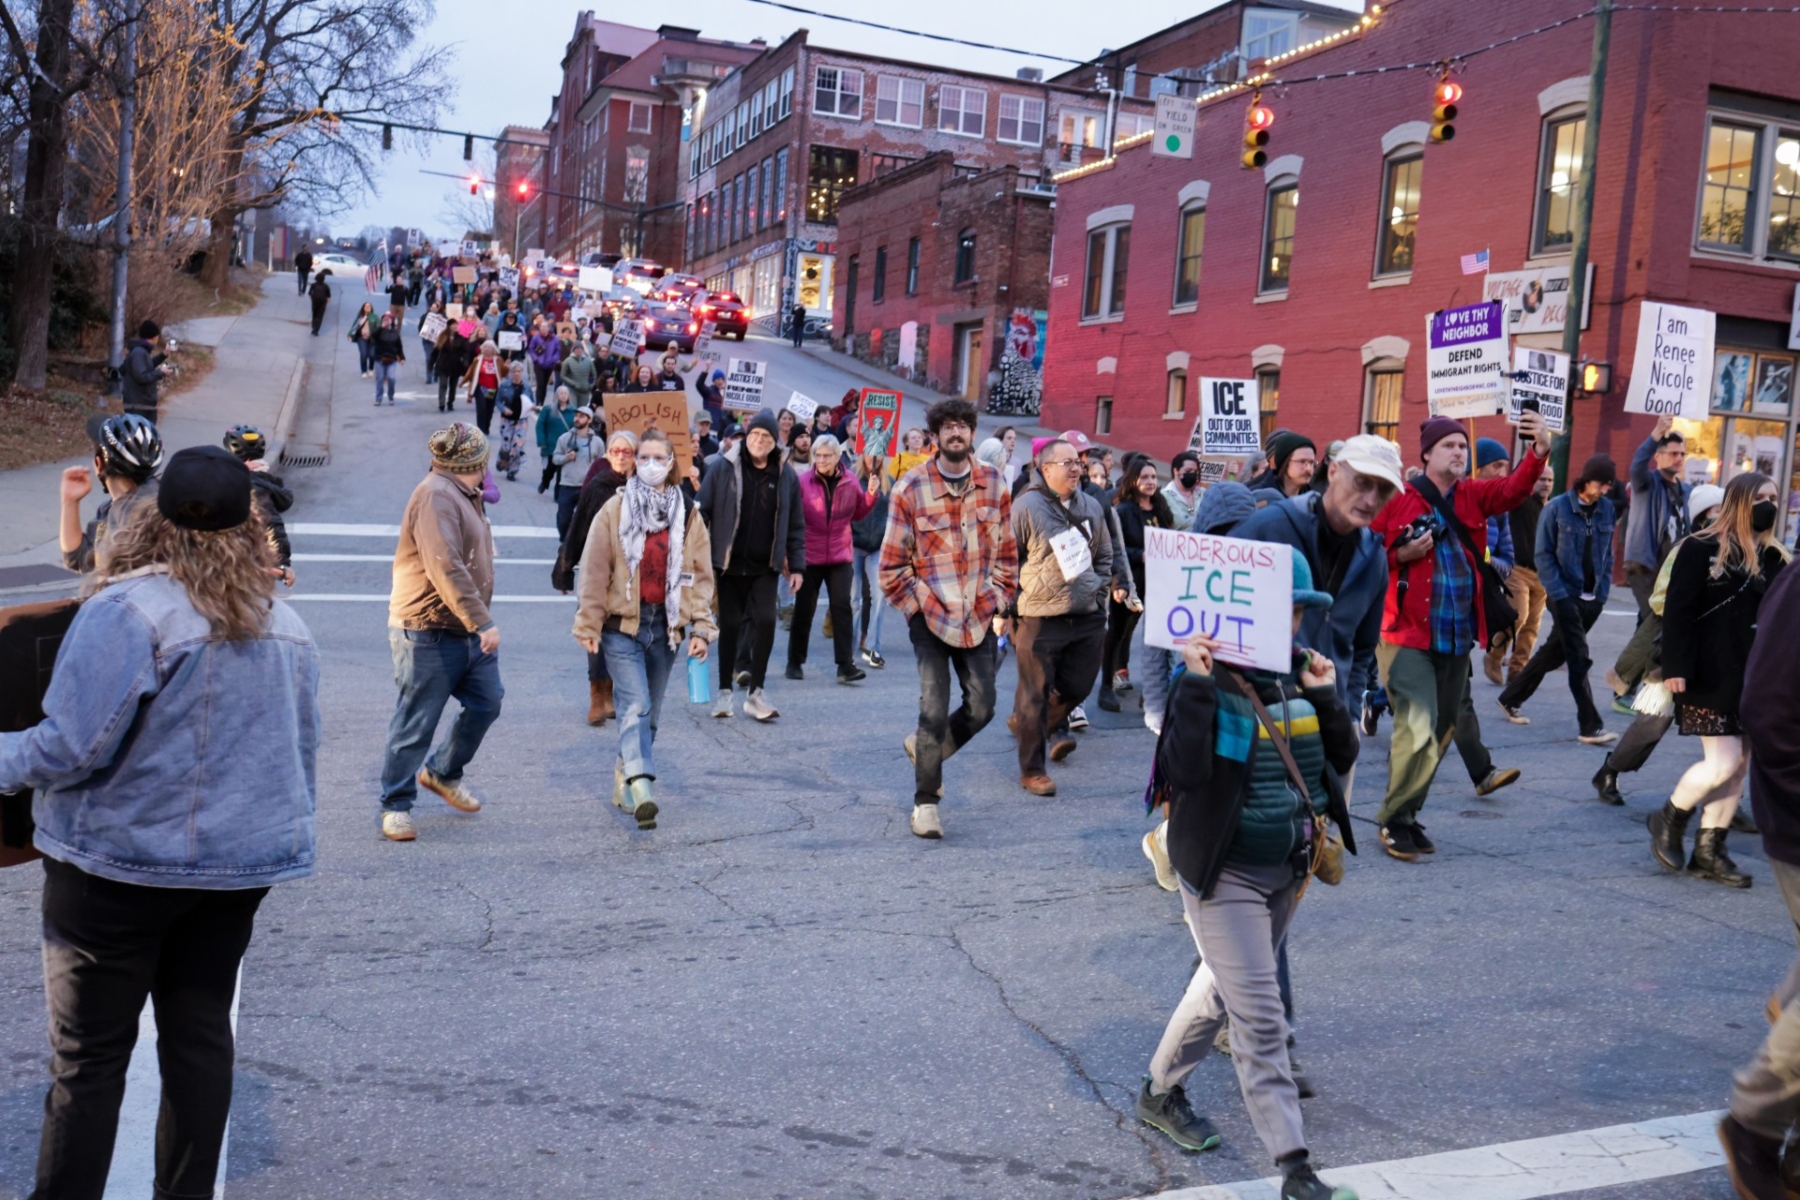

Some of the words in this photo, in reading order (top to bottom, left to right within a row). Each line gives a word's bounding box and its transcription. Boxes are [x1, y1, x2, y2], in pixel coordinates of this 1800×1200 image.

[1166, 111, 1188, 122] YIELD
[1158, 121, 1167, 129] ON
[1172, 124, 1192, 133] GREEN
[1472, 307, 1490, 322] THY
[1656, 306, 1663, 332] I
[1667, 317, 1688, 336] am
[1442, 322, 1489, 342] NEIGHBOR
[1448, 348, 1483, 363] DEFEND
[1654, 333, 1696, 364] Renee
[728, 372, 751, 384] JUSTICE
[752, 376, 763, 385] FOR
[1431, 365, 1472, 379] IMMIGRANT
[1474, 362, 1502, 374] RIGHTS
[1650, 361, 1694, 390] Nicole
[727, 384, 761, 394] RENEE
[1549, 376, 1565, 391] FOR
[726, 392, 745, 401] NICOLE
[745, 394, 761, 403] GOOD
[866, 394, 896, 408] RESIST
[1212, 381, 1247, 416] ICE
[1513, 388, 1563, 405] RENEE
[1645, 388, 1683, 416] Good
[610, 402, 682, 431] ABOLISH
[1541, 403, 1563, 419] GOOD
[1208, 418, 1223, 431] OUT
[1225, 419, 1234, 431] OF
[1235, 419, 1252, 431] OUR
[1205, 431, 1258, 444] COMMUNITIES
[1148, 531, 1275, 569] MURDEROUS
[1177, 566, 1254, 606] ICE
[1167, 605, 1254, 653] OUT
